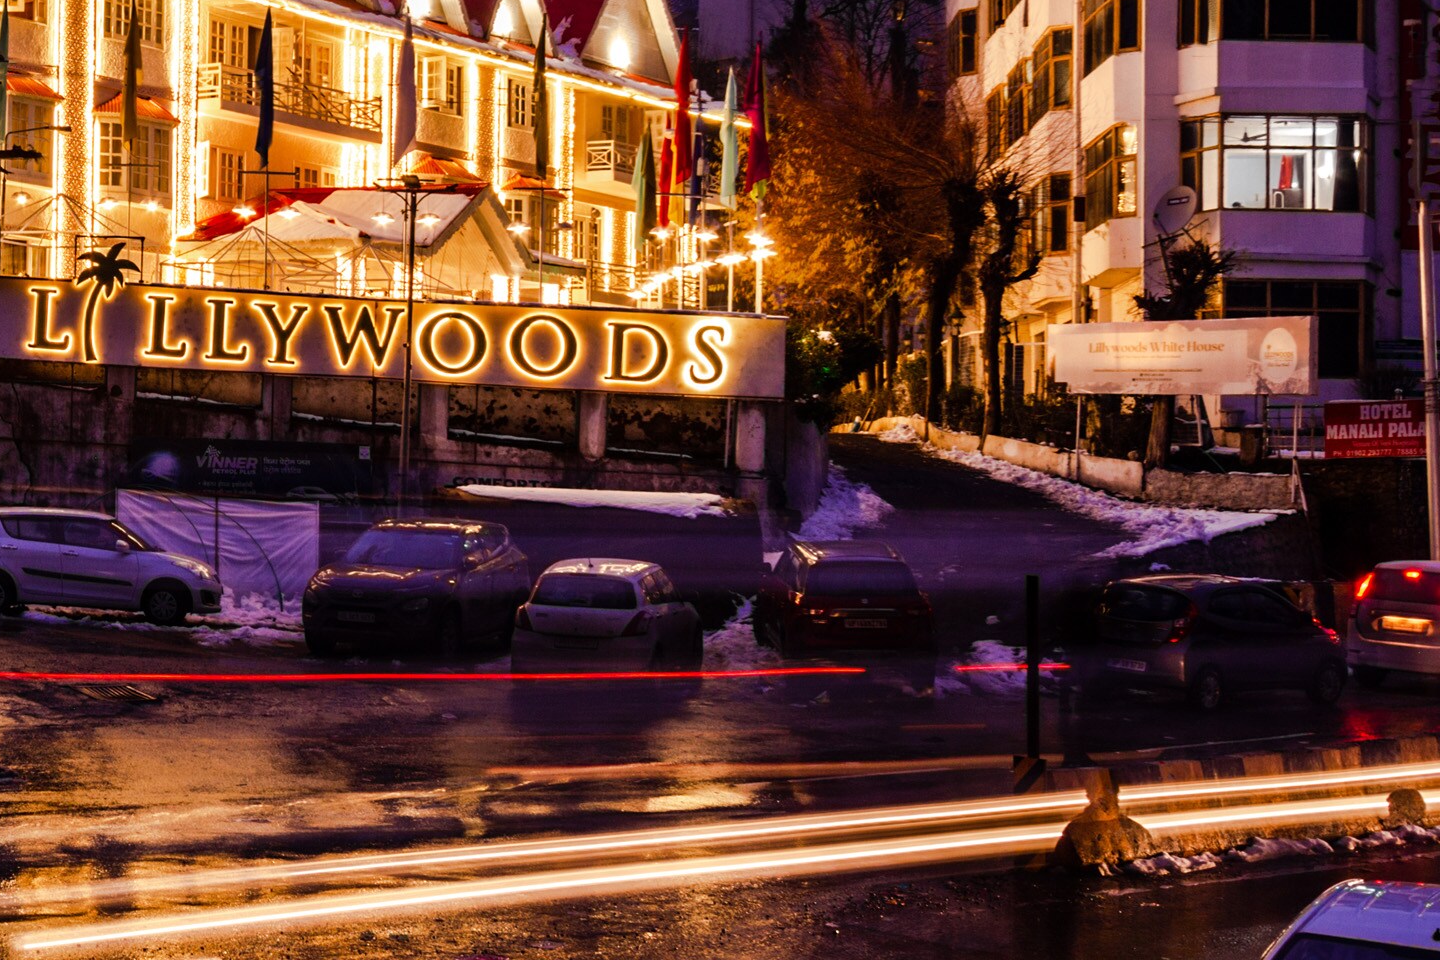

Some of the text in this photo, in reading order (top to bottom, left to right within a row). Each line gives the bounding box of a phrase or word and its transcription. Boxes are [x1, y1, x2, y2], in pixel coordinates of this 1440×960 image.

[1089, 341, 1225, 355] Lillywoods White House
[1360, 404, 1412, 420] HOTEL
[1326, 422, 1426, 440] MANALI PALA
[195, 453, 259, 470] VINNER
